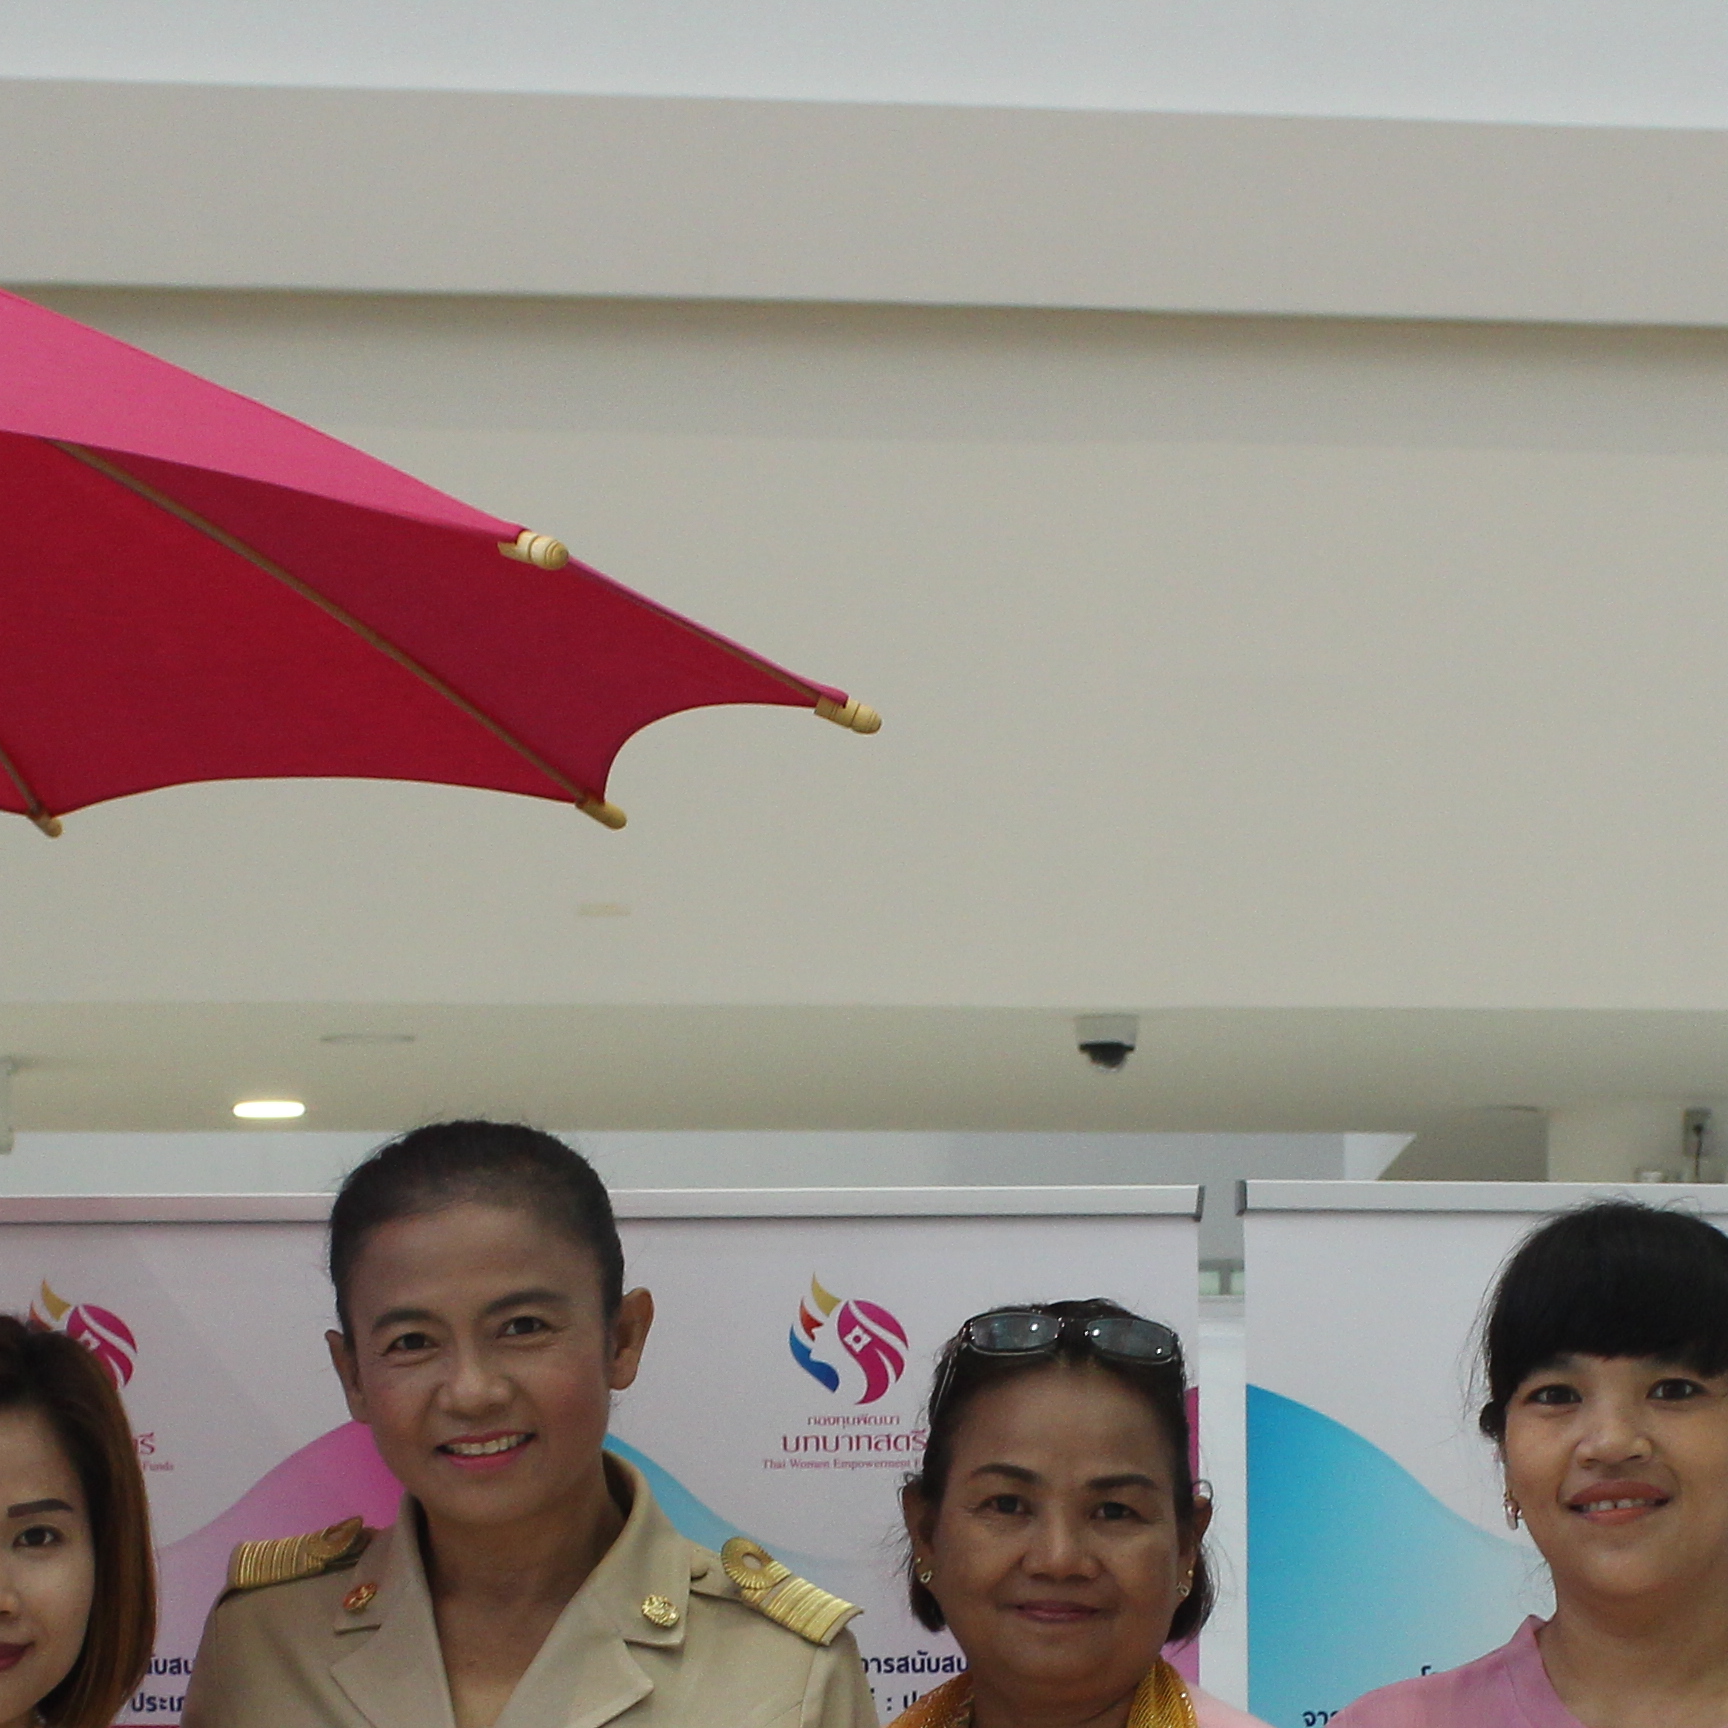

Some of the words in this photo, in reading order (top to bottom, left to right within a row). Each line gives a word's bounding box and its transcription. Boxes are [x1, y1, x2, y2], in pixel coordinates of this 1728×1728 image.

[782, 1428, 928, 1453] บทบาทสตรี
[763, 1459, 785, 1469] Thai
[790, 1459, 830, 1469] Women
[834, 1458, 911, 1471] Empowerment
